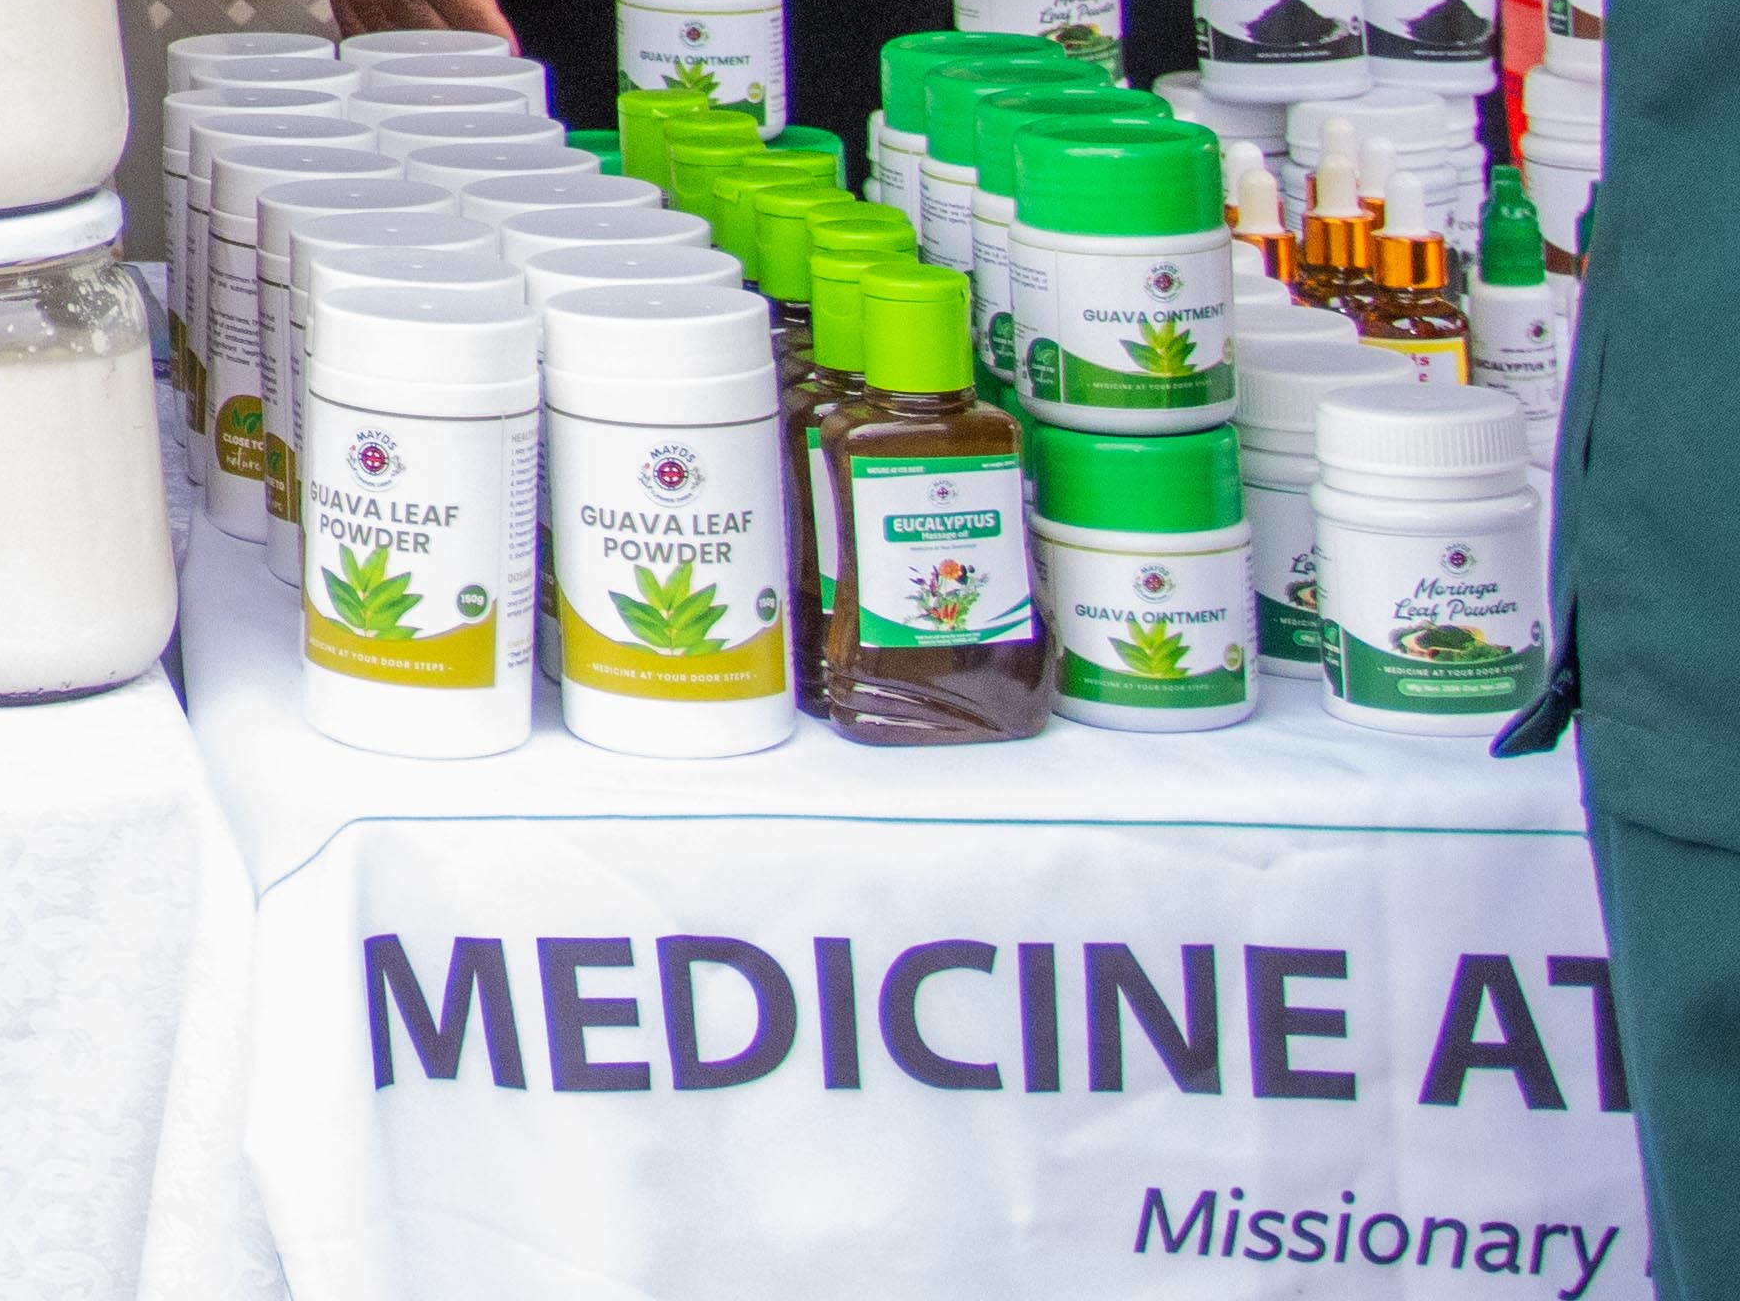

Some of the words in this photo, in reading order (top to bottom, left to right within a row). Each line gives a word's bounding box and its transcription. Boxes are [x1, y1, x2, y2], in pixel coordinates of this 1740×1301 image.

[640, 50, 681, 64] GUAVA
[685, 55, 750, 66] OINTMENT
[1083, 309, 1149, 324] GUAVA
[1155, 302, 1225, 324] OINTMENT
[310, 480, 382, 521] GUAVA
[391, 502, 459, 527] LEAF
[581, 505, 684, 536] GUAVA
[693, 510, 753, 535] LEAF
[892, 512, 997, 533] EUCALYPTUS
[321, 513, 431, 555] POWDER
[921, 531, 957, 542] Massage
[604, 537, 732, 565] POWDER
[1415, 579, 1500, 599] Moringa
[1075, 604, 1136, 623] GUAVA
[1143, 608, 1227, 625] OINTMENT
[1394, 598, 1440, 623] Leaf
[1448, 599, 1519, 619] Powder
[592, 663, 636, 678] MEDICINE
[640, 672, 652, 680] AT
[658, 673, 687, 682] YOUR
[691, 674, 721, 683] DOOR
[724, 672, 751, 681] STEPS
[364, 934, 1359, 1105] MEDICINE
[1421, 952, 1640, 1118] AT
[1135, 1188, 1621, 1301] Missionary
